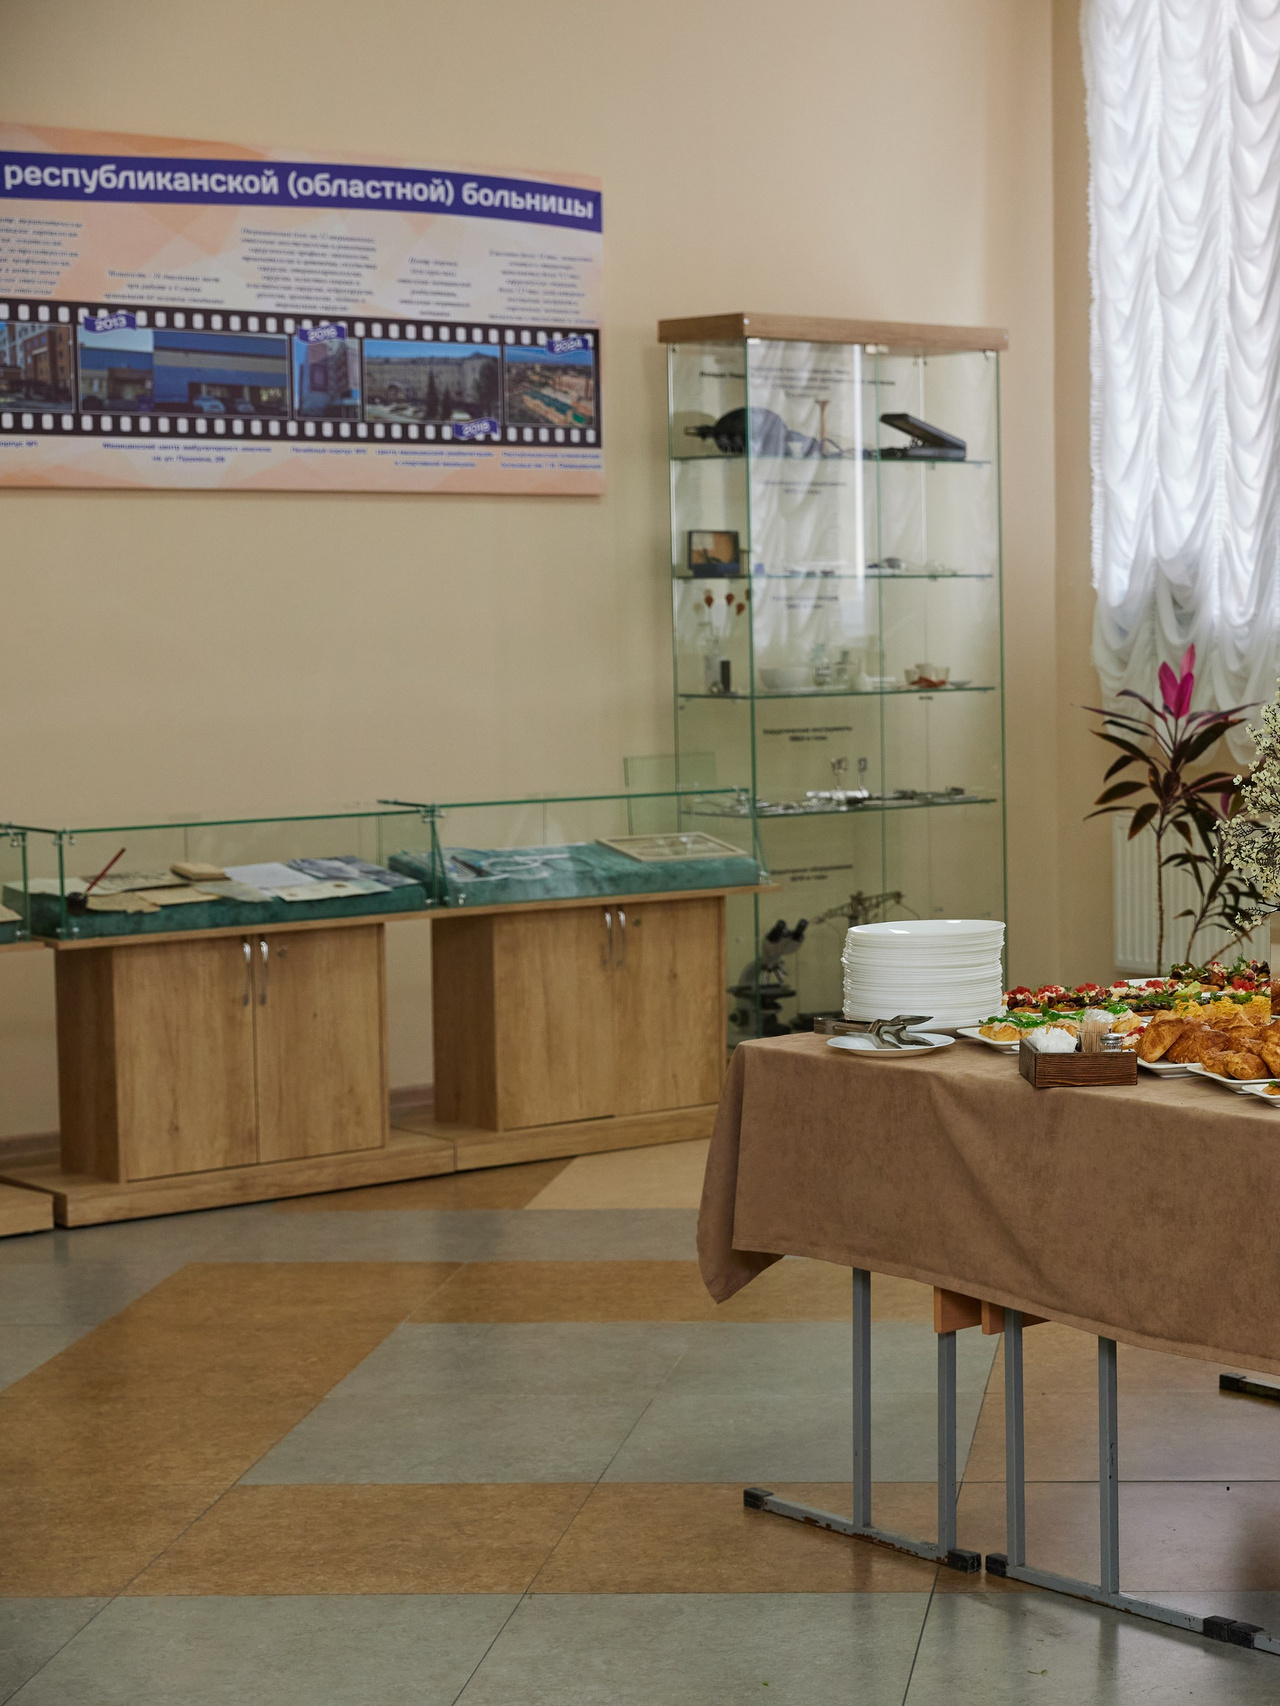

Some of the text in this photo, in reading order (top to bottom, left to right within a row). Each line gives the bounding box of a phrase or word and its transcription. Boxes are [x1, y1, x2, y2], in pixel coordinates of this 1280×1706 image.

[4, 164, 594, 219] республиканской (областной) больницы
